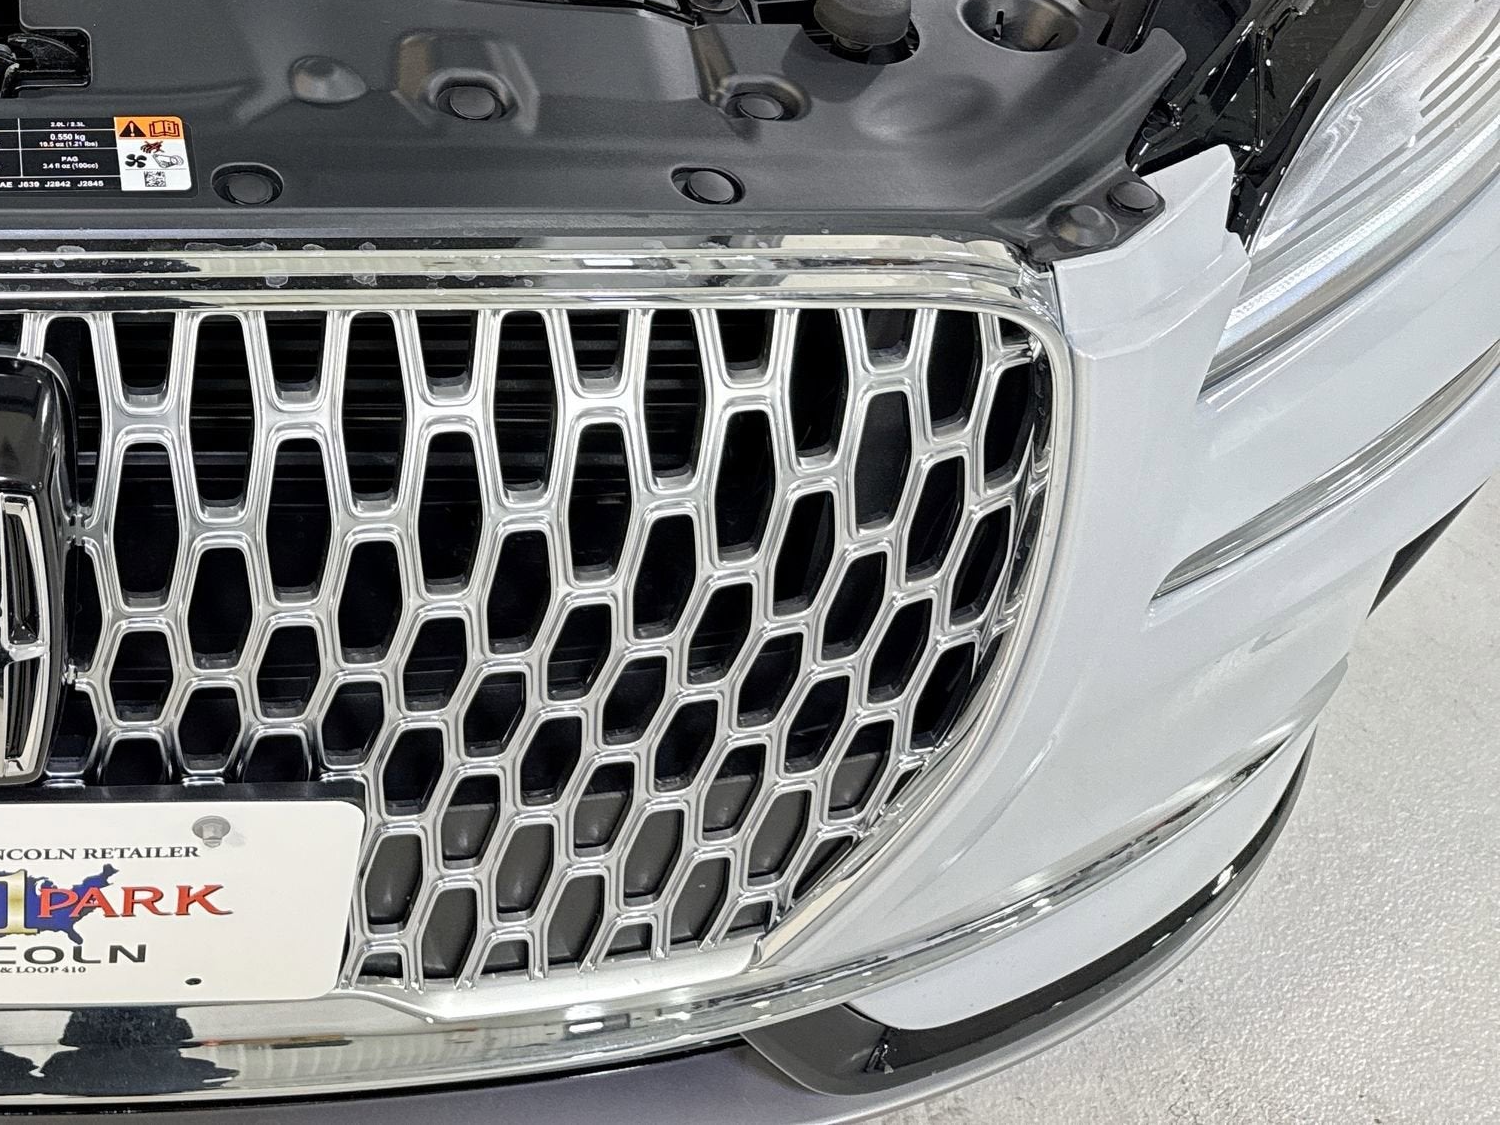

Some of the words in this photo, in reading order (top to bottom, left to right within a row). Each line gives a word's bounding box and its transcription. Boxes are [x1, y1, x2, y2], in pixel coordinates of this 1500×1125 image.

[50, 133, 73, 141] 0.550
[74, 133, 86, 141] kg
[83, 846, 200, 859] RETAILER
[37, 884, 234, 918] PARK
